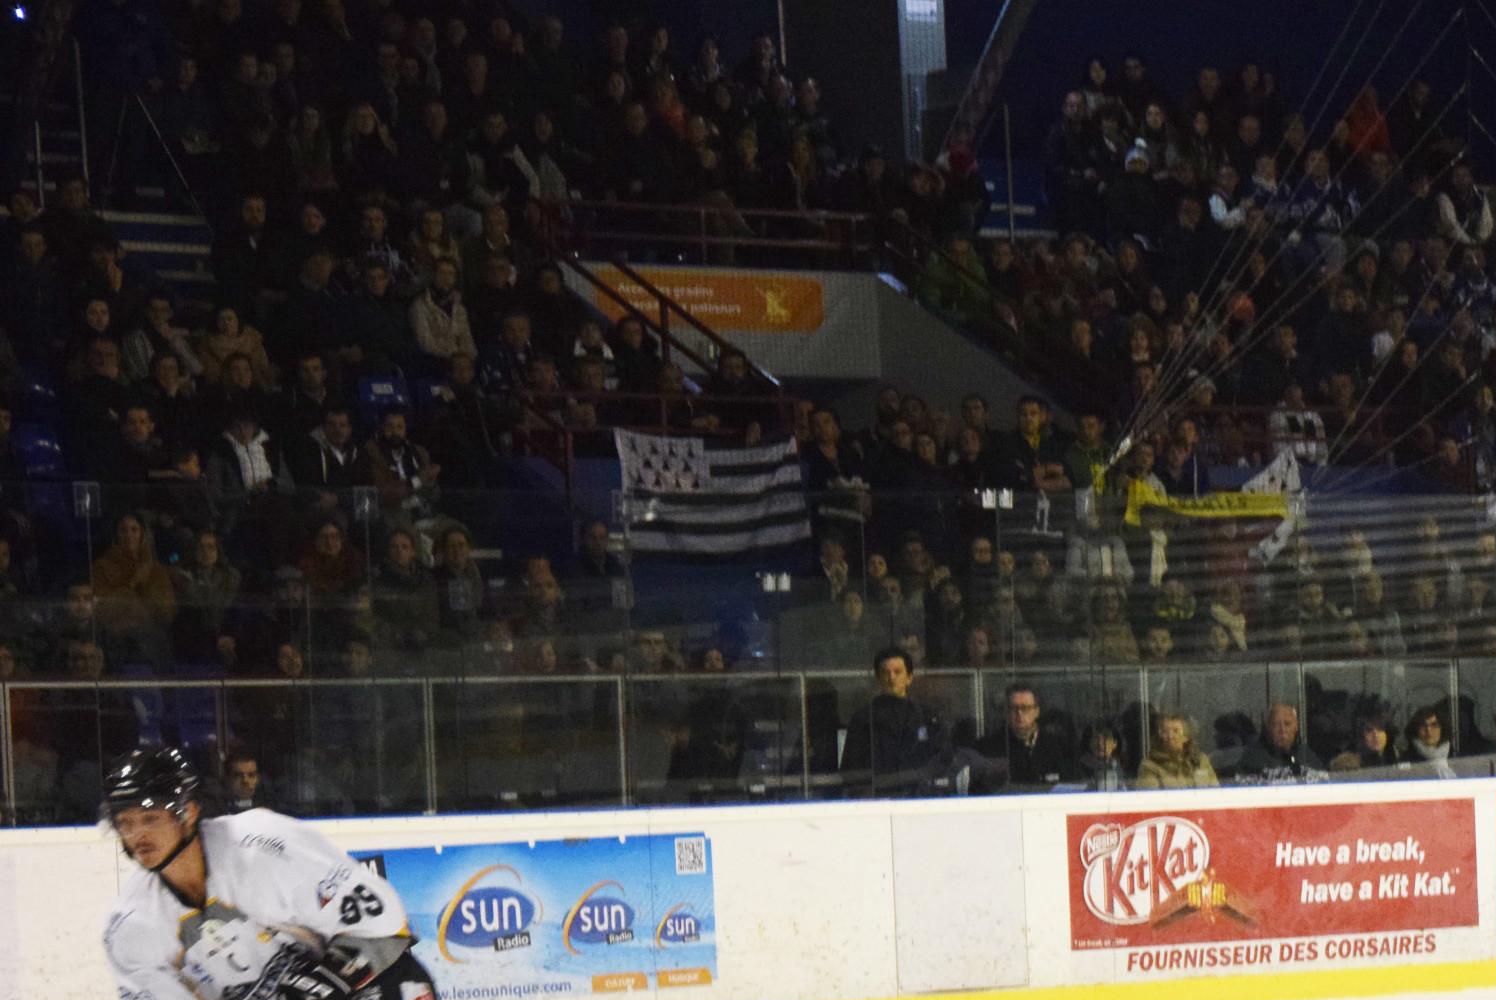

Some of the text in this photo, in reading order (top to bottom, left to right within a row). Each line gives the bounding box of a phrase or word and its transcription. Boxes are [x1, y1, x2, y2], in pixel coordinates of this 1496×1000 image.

[1275, 836, 1426, 868] Have a break,
[1300, 878, 1354, 904] have
[1359, 883, 1371, 901] a
[1378, 875, 1410, 899] Kit
[461, 896, 524, 934] sun
[579, 903, 626, 933] sun
[667, 917, 696, 937] sun
[497, 934, 530, 950] Radio
[1126, 941, 1273, 973] FOURNISSEUR
[1279, 939, 1318, 963] DES
[1324, 933, 1437, 960] CORSAIRES
